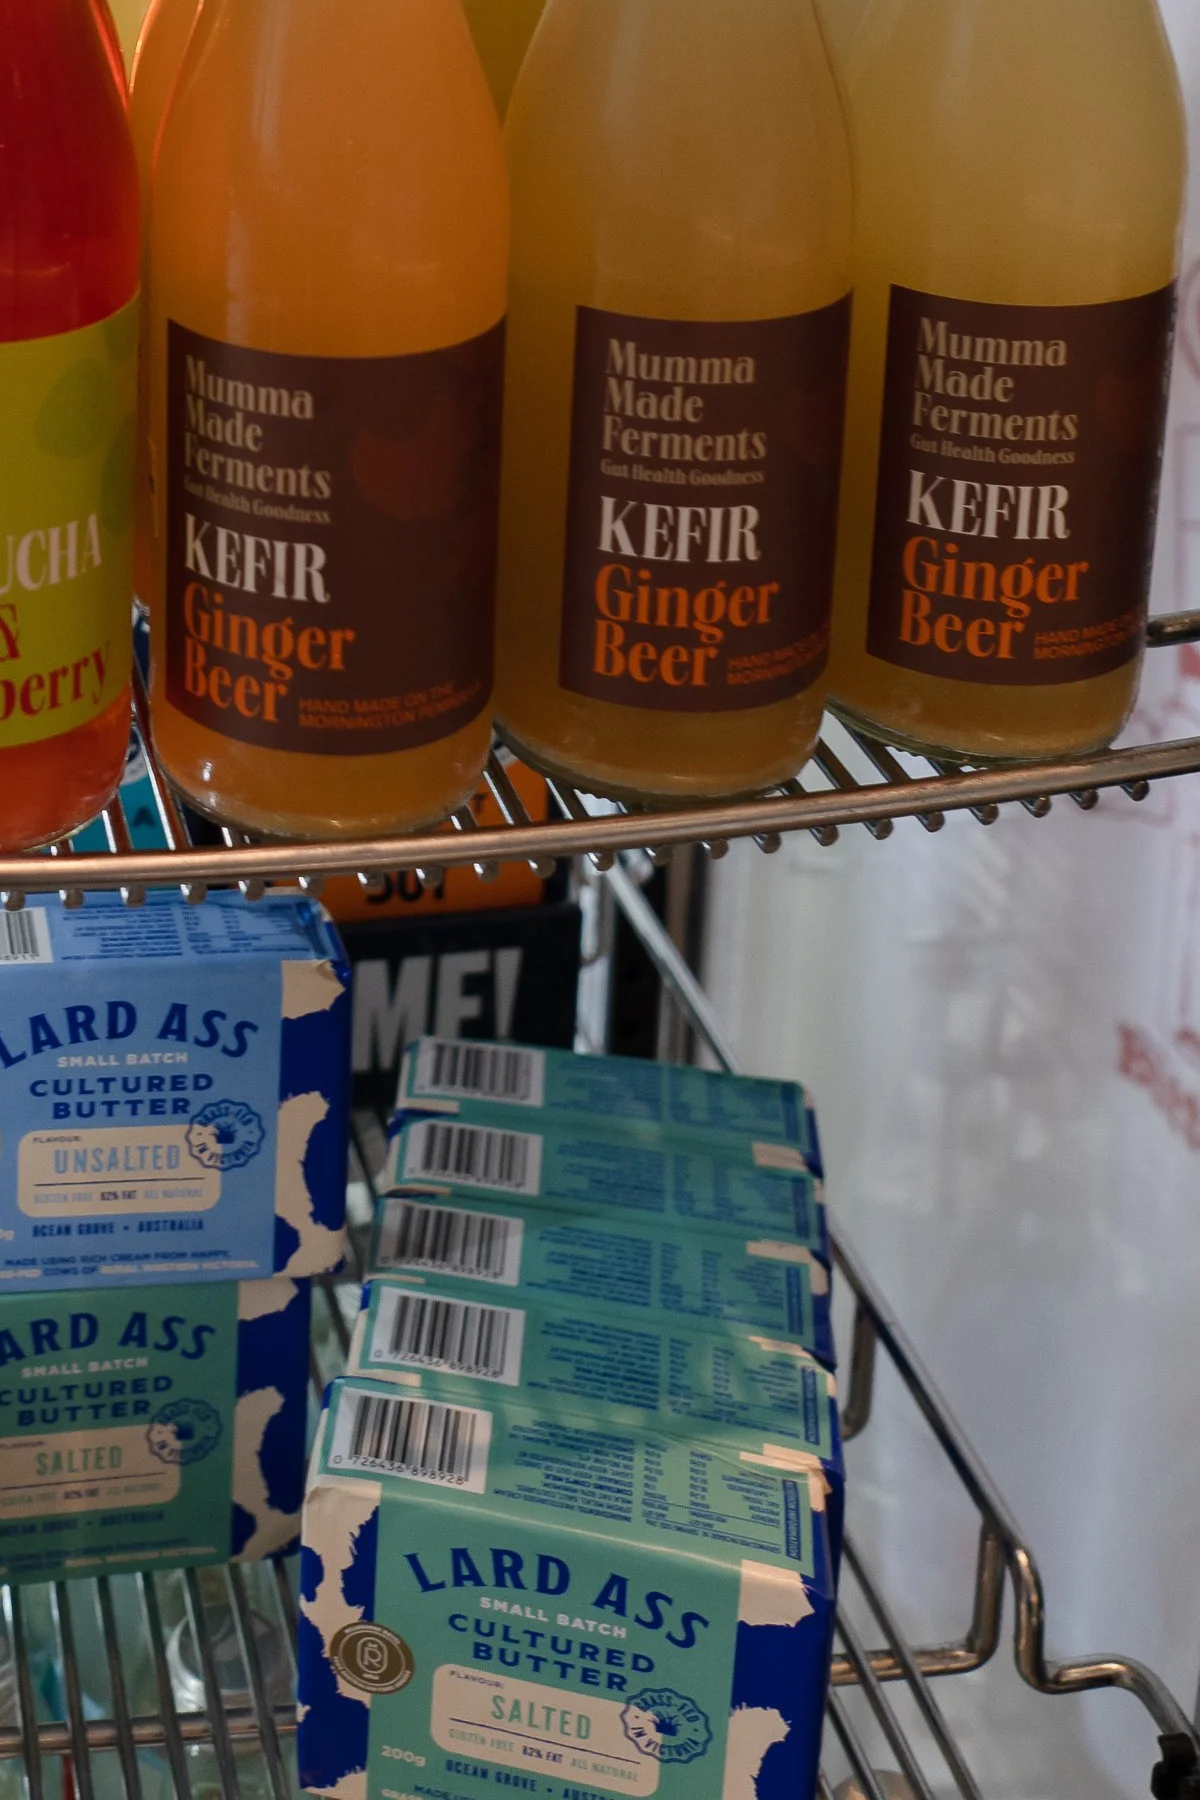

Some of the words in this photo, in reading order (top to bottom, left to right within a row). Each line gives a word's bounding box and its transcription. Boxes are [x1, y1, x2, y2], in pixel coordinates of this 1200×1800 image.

[605, 338, 755, 385] Mumma
[916, 317, 1067, 367] Mumma
[184, 354, 314, 420] Mumma
[604, 377, 704, 423] Made
[914, 354, 1015, 402] Made
[184, 394, 263, 452] Made
[601, 414, 768, 461] Ferments
[912, 392, 1078, 441] Ferments
[184, 432, 331, 499] Ferments
[597, 495, 762, 563] KEFIR
[906, 470, 1071, 539] KEFIR
[184, 512, 330, 604] KEFIR
[902, 535, 1089, 618] Ginger
[594, 563, 780, 643] Ginger
[900, 588, 1026, 660] Beer
[183, 582, 356, 680] Ginger
[593, 618, 719, 686] Beer
[185, 637, 288, 723] Beer
[157, 1002, 259, 1058] ASS
[57, 1054, 119, 1067] SMALL
[126, 1052, 188, 1065] BATCH
[29, 1074, 213, 1097] CULTURED
[53, 1098, 191, 1120] BUTTER
[54, 1144, 180, 1175] UNSALTED
[120, 1311, 217, 1360] ASS
[18, 1400, 152, 1427] BUTTER
[36, 1445, 122, 1477] SALTED
[333, 1455, 342, 1464] 0
[352, 1456, 405, 1473] 726436
[411, 1467, 464, 1485] 898928
[403, 1548, 570, 1595] LARD
[592, 1574, 710, 1649] ASS
[479, 1596, 548, 1622] SMALL
[556, 1612, 627, 1640] BATCH
[448, 1613, 655, 1674] CULTURED
[472, 1642, 628, 1693] BUTTER
[491, 1695, 591, 1741] SALTED
[381, 1744, 426, 1767] 200g
[446, 1759, 489, 1780] OCEAN
[494, 1771, 538, 1792] GROVE
